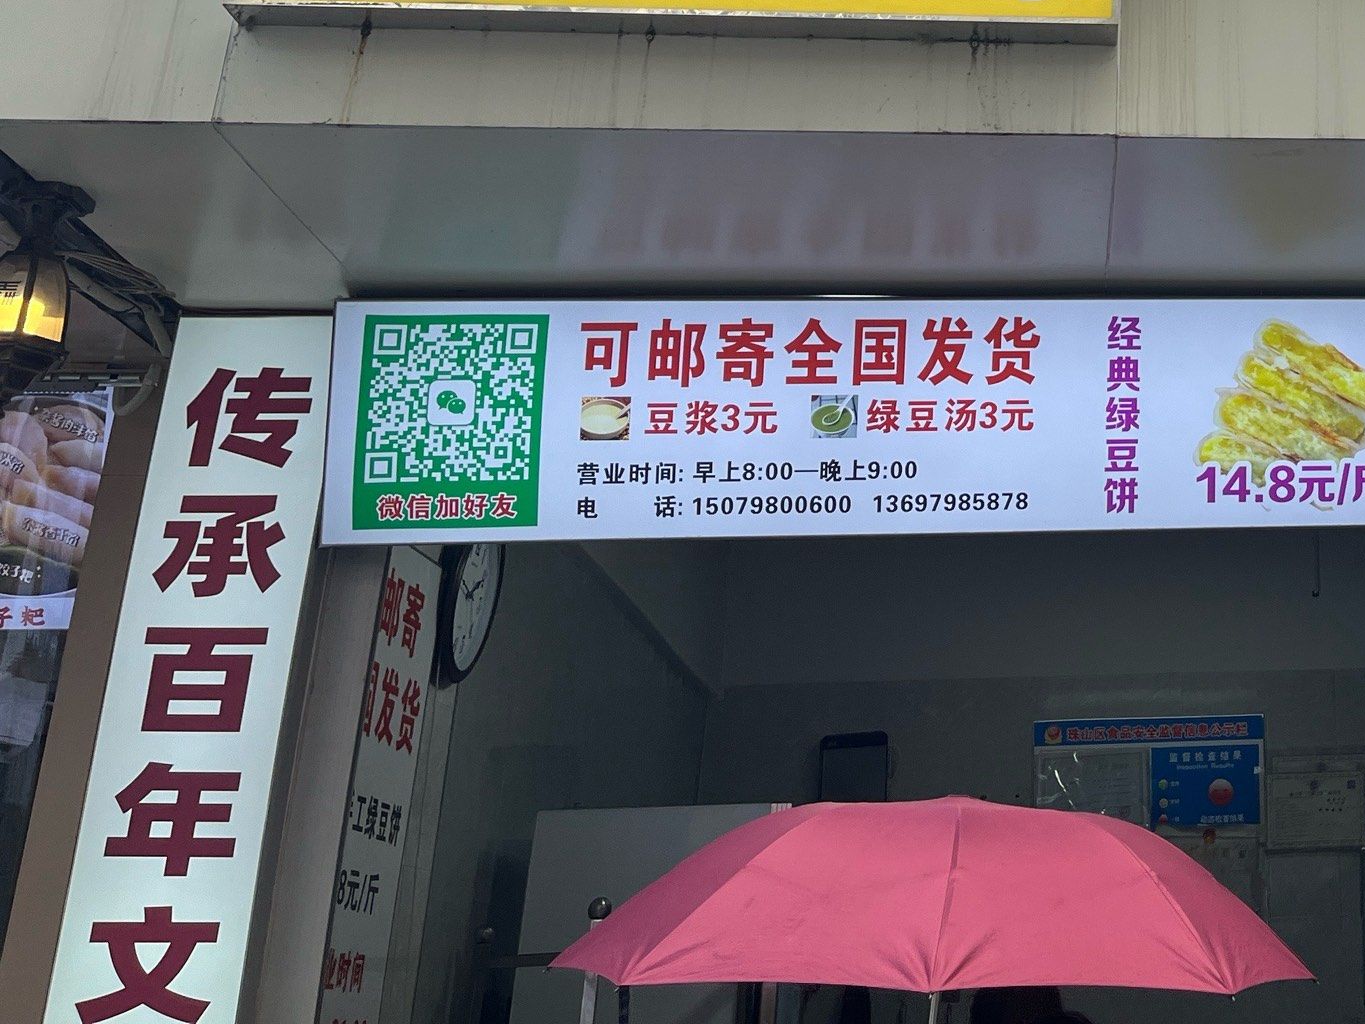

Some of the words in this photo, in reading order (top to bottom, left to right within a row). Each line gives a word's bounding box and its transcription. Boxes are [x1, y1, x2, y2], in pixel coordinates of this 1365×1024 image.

[580, 315, 1042, 388] 可邮寄全国发货
[644, 401, 779, 436] 豆浆3元
[865, 398, 1035, 435] 绿豆汤3元
[1103, 315, 1142, 515] 经典绿豆饼
[376, 493, 518, 521] 微信加好友
[872, 492, 1029, 515] 13697985878
[75, 366, 313, 1024] 传承百年文
[350, 788, 403, 847] 工绿豆饼
